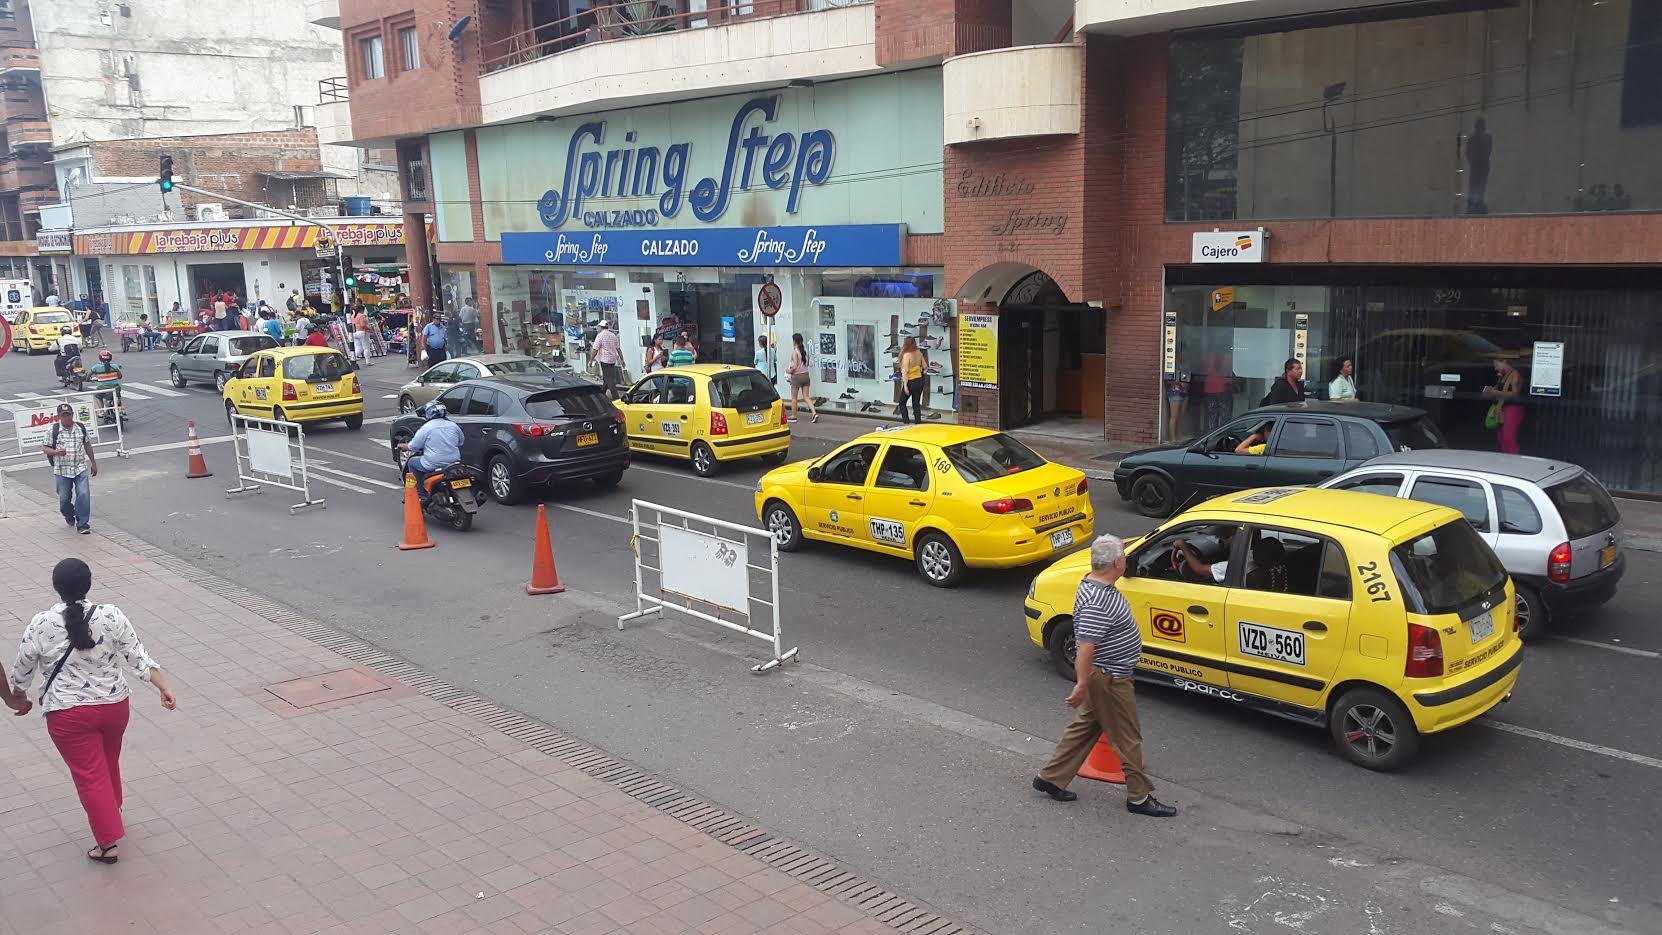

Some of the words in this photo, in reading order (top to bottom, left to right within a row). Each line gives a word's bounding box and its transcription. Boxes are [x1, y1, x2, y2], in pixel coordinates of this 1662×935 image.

[537, 120, 692, 229] Spring
[689, 94, 837, 224] Step
[958, 168, 1034, 198] Edificio
[583, 208, 660, 229] CALZADO
[991, 208, 1068, 236] Spring
[155, 234, 167, 246] la
[169, 232, 207, 249] rebaja
[210, 229, 238, 246] plus
[336, 228, 374, 243] rebaja
[375, 226, 403, 239] plus
[545, 234, 579, 263] Spring
[579, 234, 608, 262] Step
[641, 239, 699, 256] CALZADO
[737, 230, 786, 263] Spring
[785, 229, 826, 264] Step
[1201, 245, 1238, 259] Cajero
[933, 457, 952, 474] 169
[1039, 512, 1059, 523] SERVICIO
[1059, 506, 1075, 517] PUBLICO
[1357, 561, 1391, 603] 2167
[1257, 650, 1288, 661] NEIVA
[1464, 652, 1488, 669] SERVICIO
[1139, 657, 1169, 670] ERVICIO
[1170, 664, 1203, 678] PUBLICO
